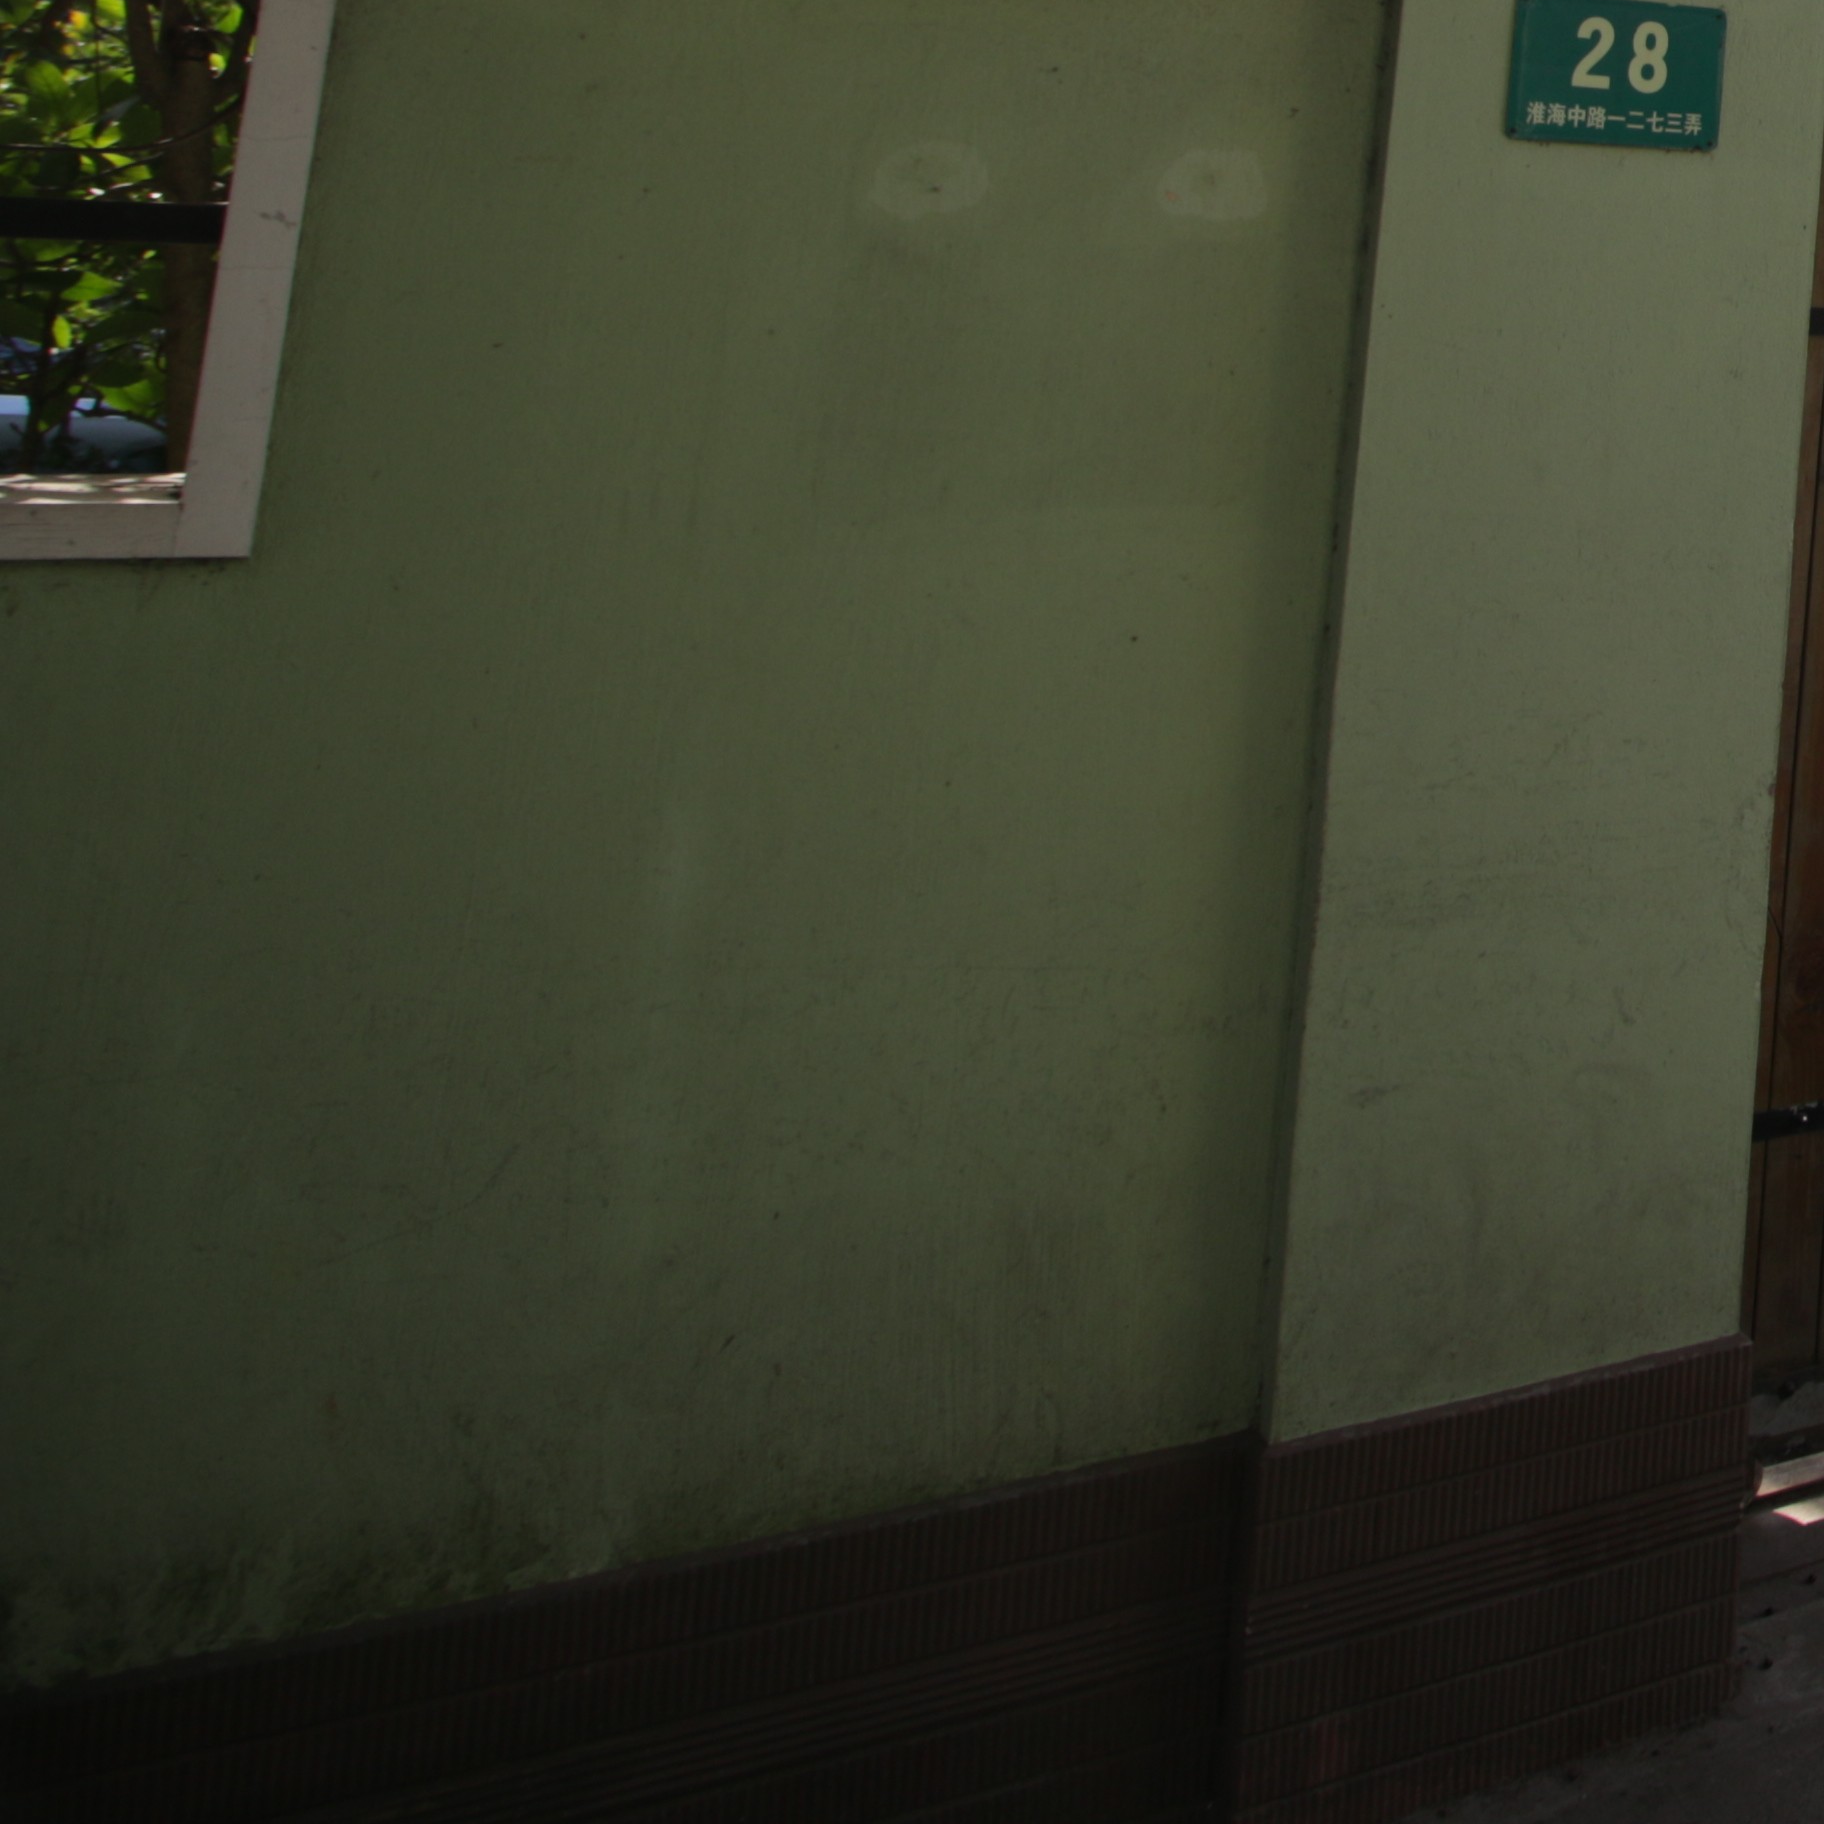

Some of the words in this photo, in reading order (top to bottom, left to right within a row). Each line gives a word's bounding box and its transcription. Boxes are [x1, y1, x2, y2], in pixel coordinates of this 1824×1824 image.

[1571, 16, 1669, 94] 28
[1526, 101, 1703, 136] 淮海中路一二七三弄
